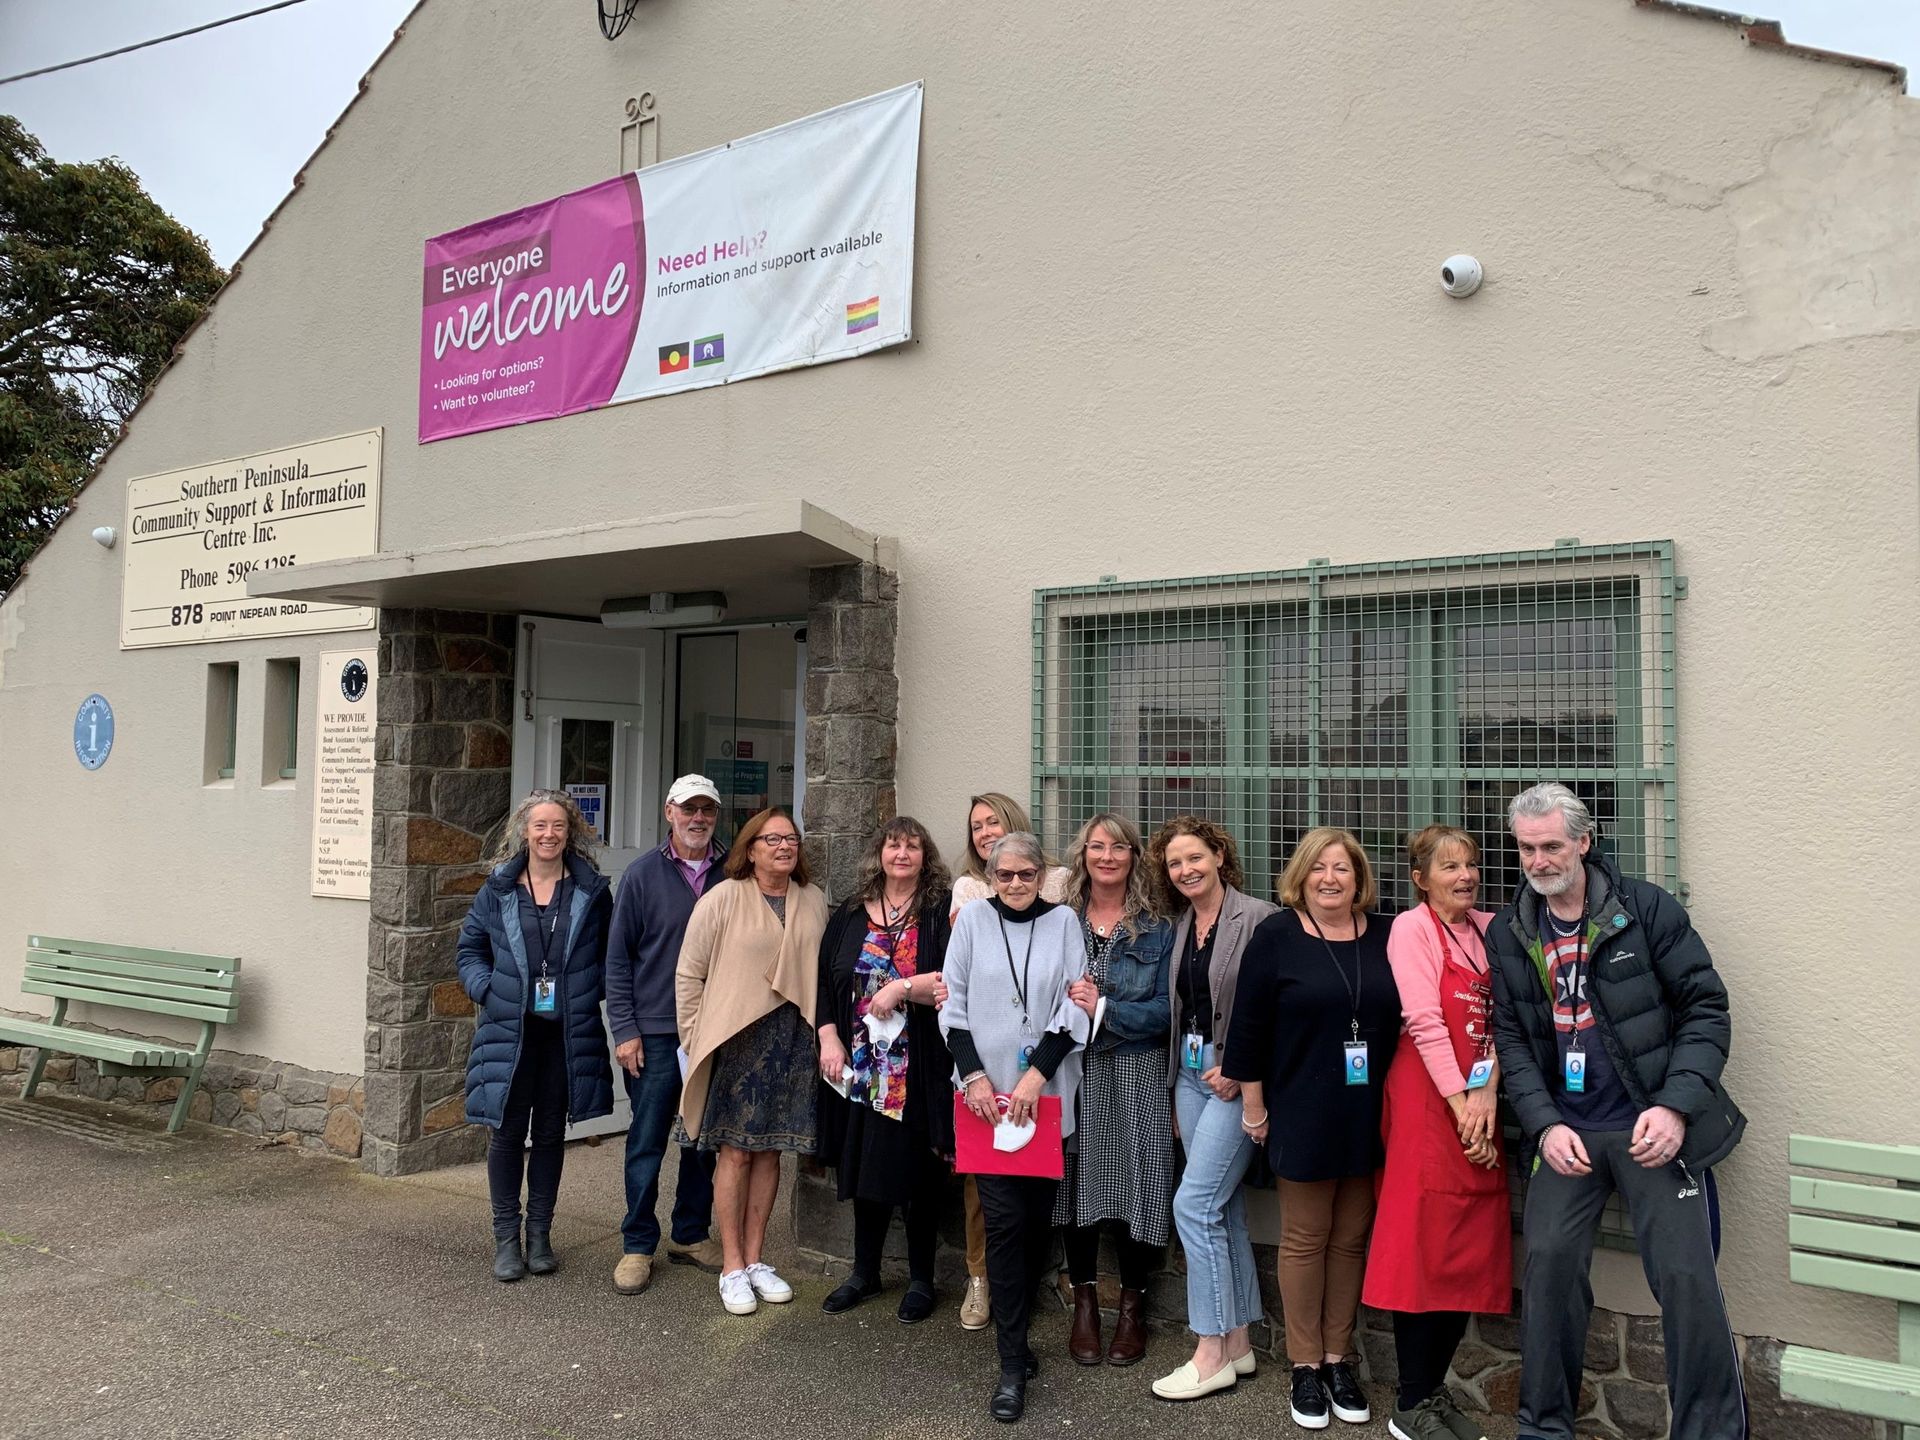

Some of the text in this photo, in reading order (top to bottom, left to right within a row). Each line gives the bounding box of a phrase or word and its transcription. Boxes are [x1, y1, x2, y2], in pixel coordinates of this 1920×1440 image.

[442, 246, 544, 293] Everyone
[657, 231, 883, 298] Information and support available
[658, 230, 767, 275] Need Help?
[433, 262, 630, 360] welcome
[440, 356, 544, 391] Looking for options?
[440, 380, 535, 412] Want to volunteer?
[180, 459, 309, 501] Southern Peninsula
[132, 478, 366, 536] Community Support & Information
[203, 522, 277, 551] Centre Inc.
[180, 566, 218, 590] Phone
[171, 603, 308, 627] 878 POINT NEPEAN ROAD
[78, 697, 112, 722] COMMUNITY
[324, 712, 367, 723] WE PROVIDE
